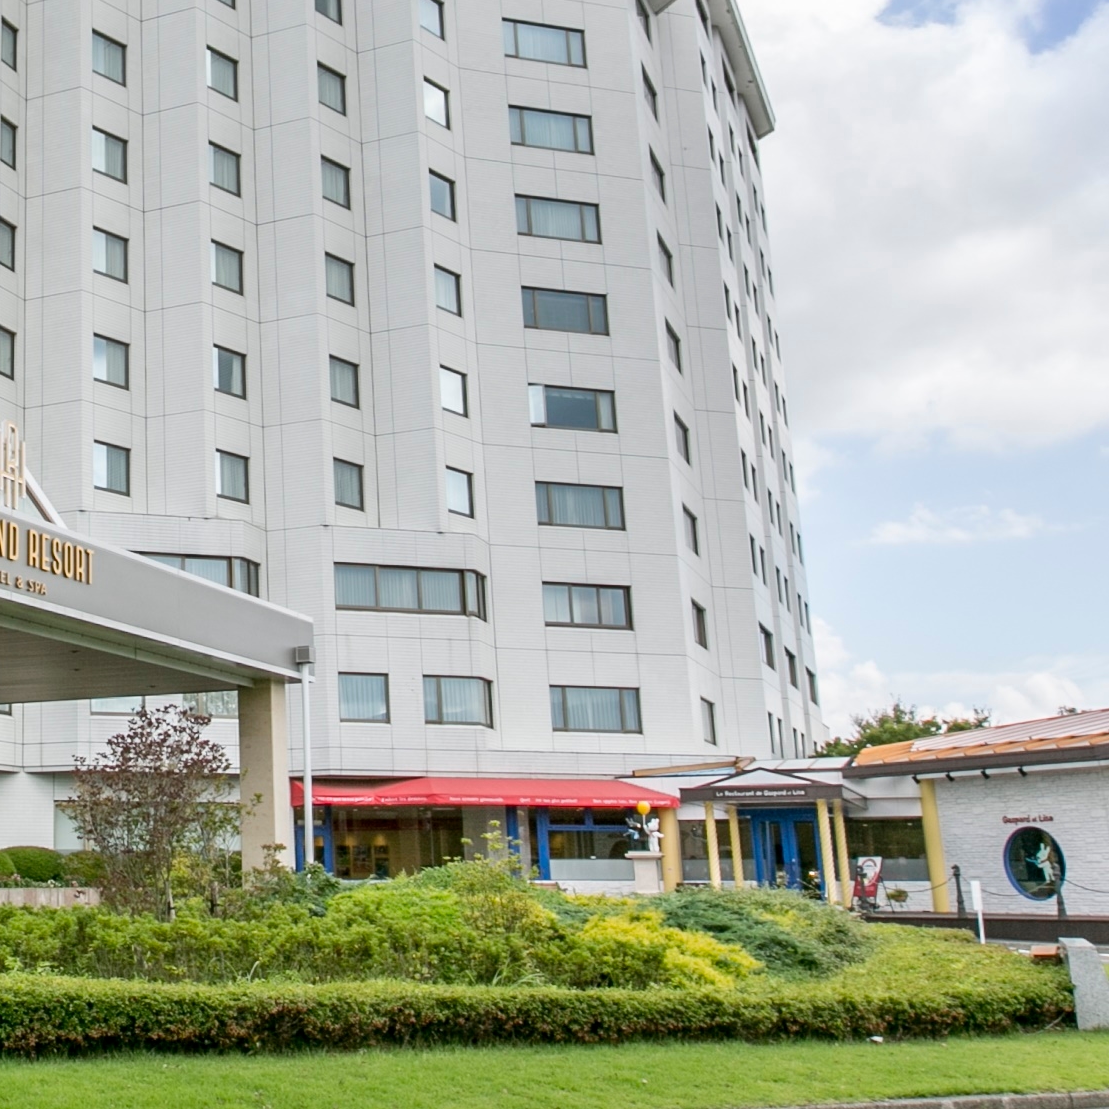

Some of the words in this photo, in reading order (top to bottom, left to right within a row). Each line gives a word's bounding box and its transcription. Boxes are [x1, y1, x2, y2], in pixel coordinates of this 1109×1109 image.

[27, 529, 95, 585] RESORT
[15, 575, 24, 589] &
[27, 579, 48, 595] SPA
